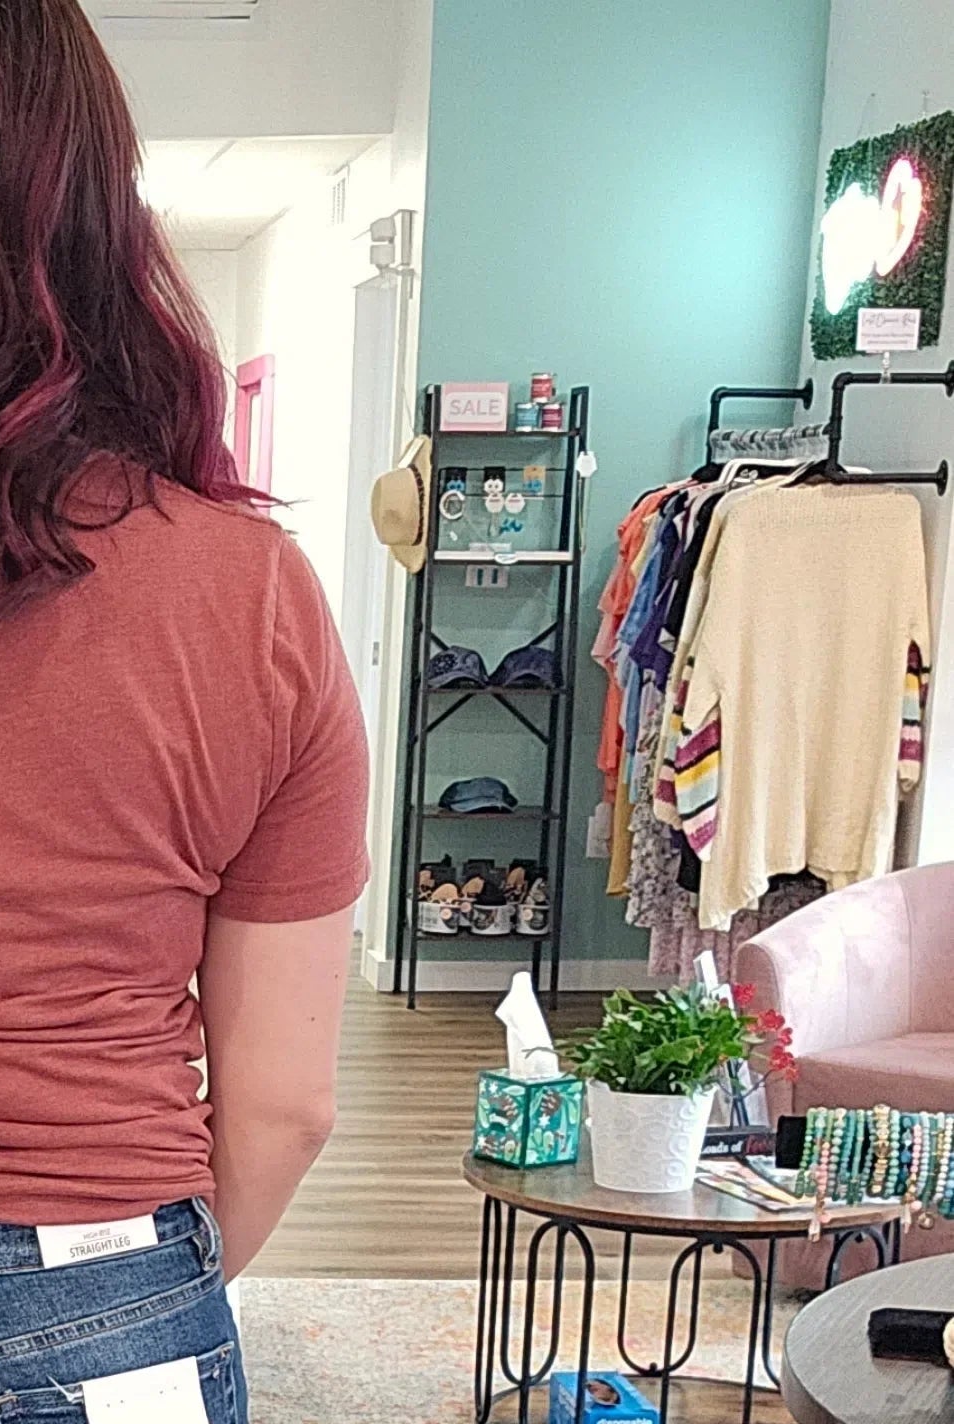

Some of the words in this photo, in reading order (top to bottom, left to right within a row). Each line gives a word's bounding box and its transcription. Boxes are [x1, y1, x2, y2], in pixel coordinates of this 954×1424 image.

[449, 399, 502, 416] SALE
[69, 1239, 113, 1258] STRAIGHT
[113, 1235, 131, 1249] LEG
